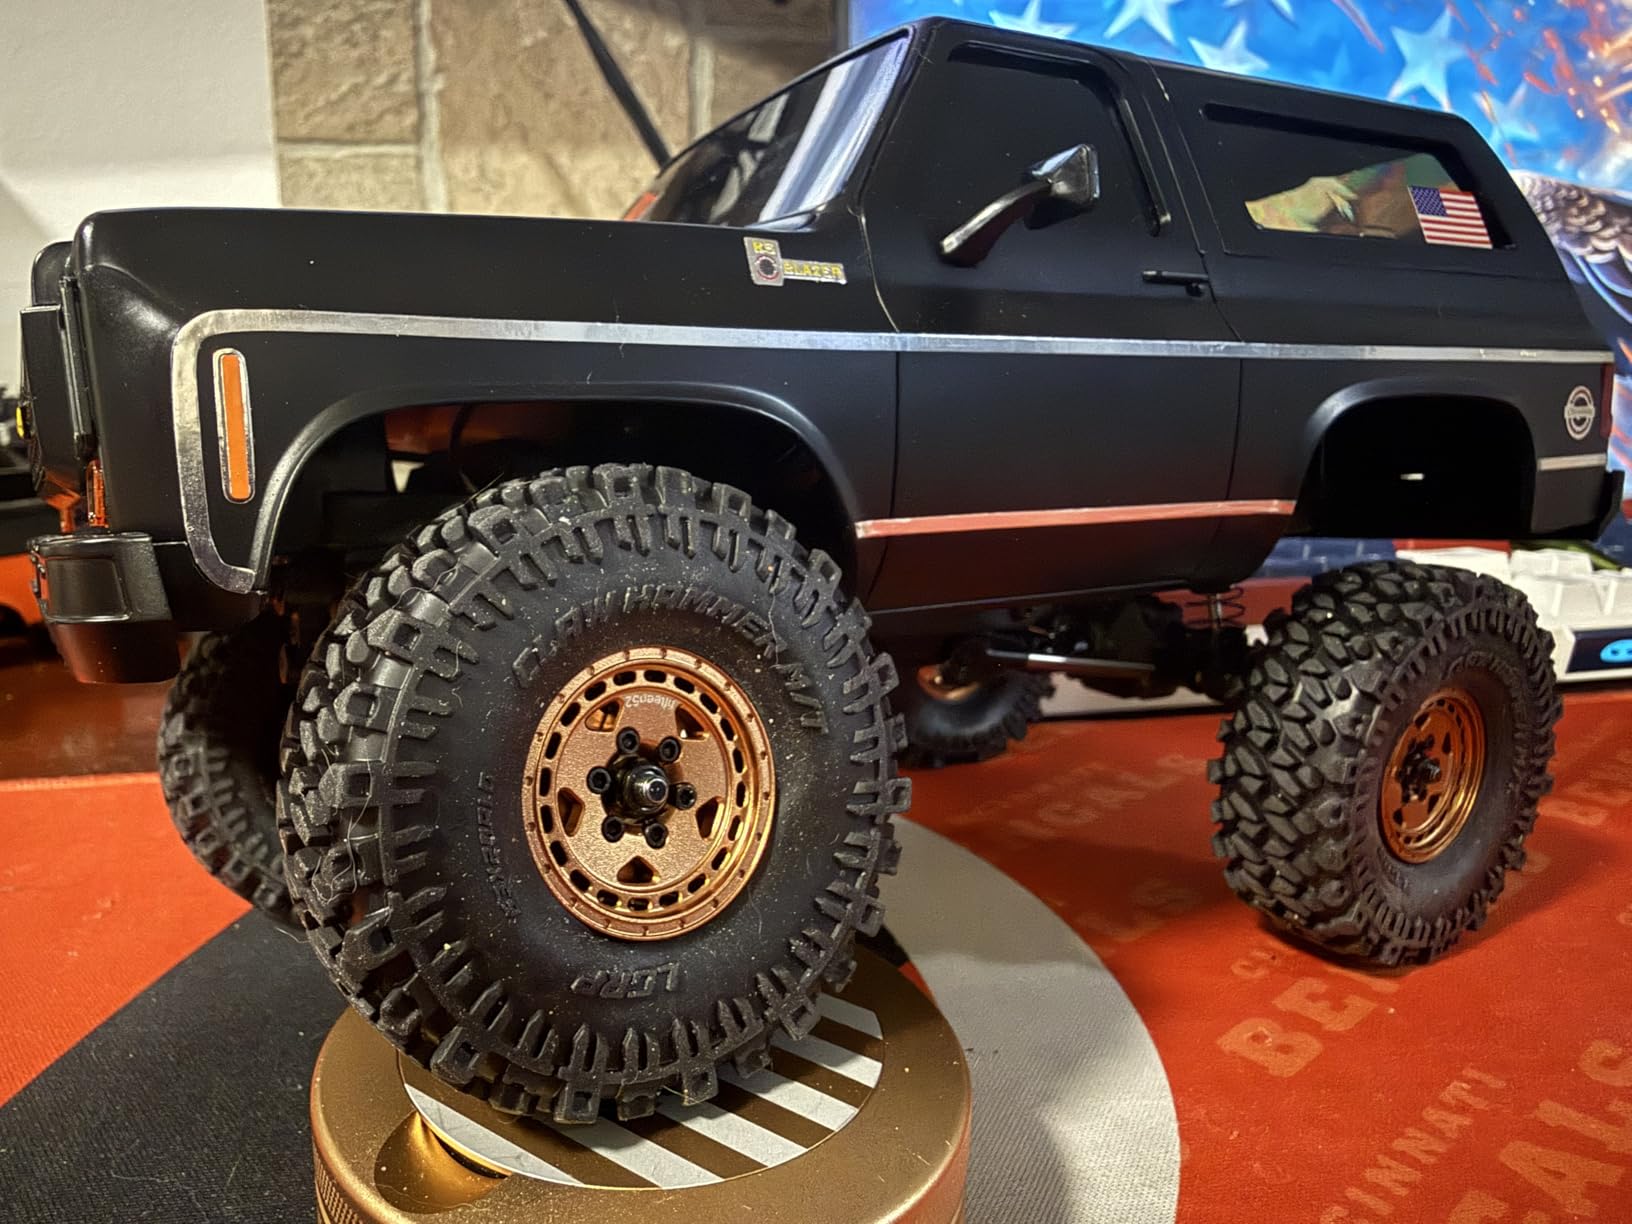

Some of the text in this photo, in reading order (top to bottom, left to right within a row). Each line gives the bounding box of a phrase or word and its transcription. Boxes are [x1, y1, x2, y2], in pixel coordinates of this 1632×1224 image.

[783, 261, 842, 279] BLAZER
[623, 584, 788, 660] HAMMER
[624, 695, 676, 710] fifteen52
